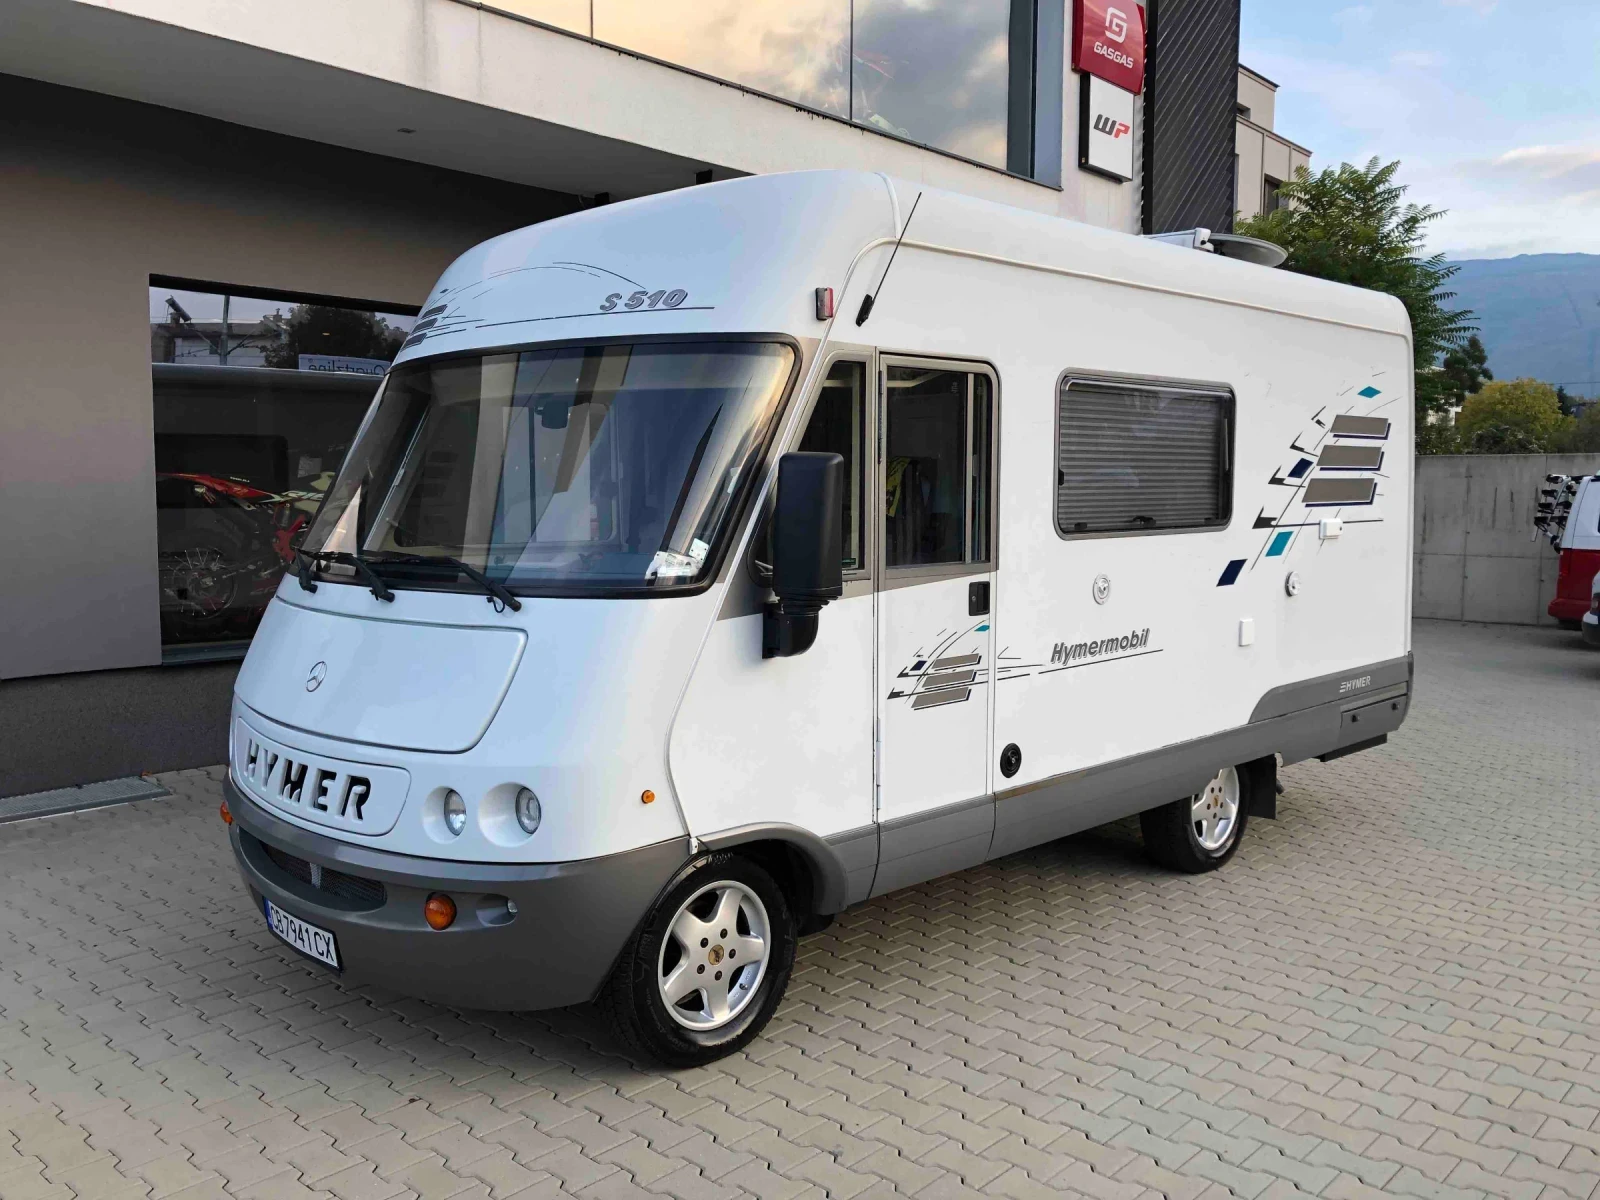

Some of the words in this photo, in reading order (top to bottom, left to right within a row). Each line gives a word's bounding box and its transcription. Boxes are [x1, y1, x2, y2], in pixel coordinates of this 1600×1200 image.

[1093, 41, 1134, 69] GASGAS
[1093, 113, 1131, 139] WP
[599, 292, 623, 312] S
[624, 288, 688, 310] 510
[1050, 627, 1151, 666] Hymermobil
[244, 738, 372, 824] HYMER
